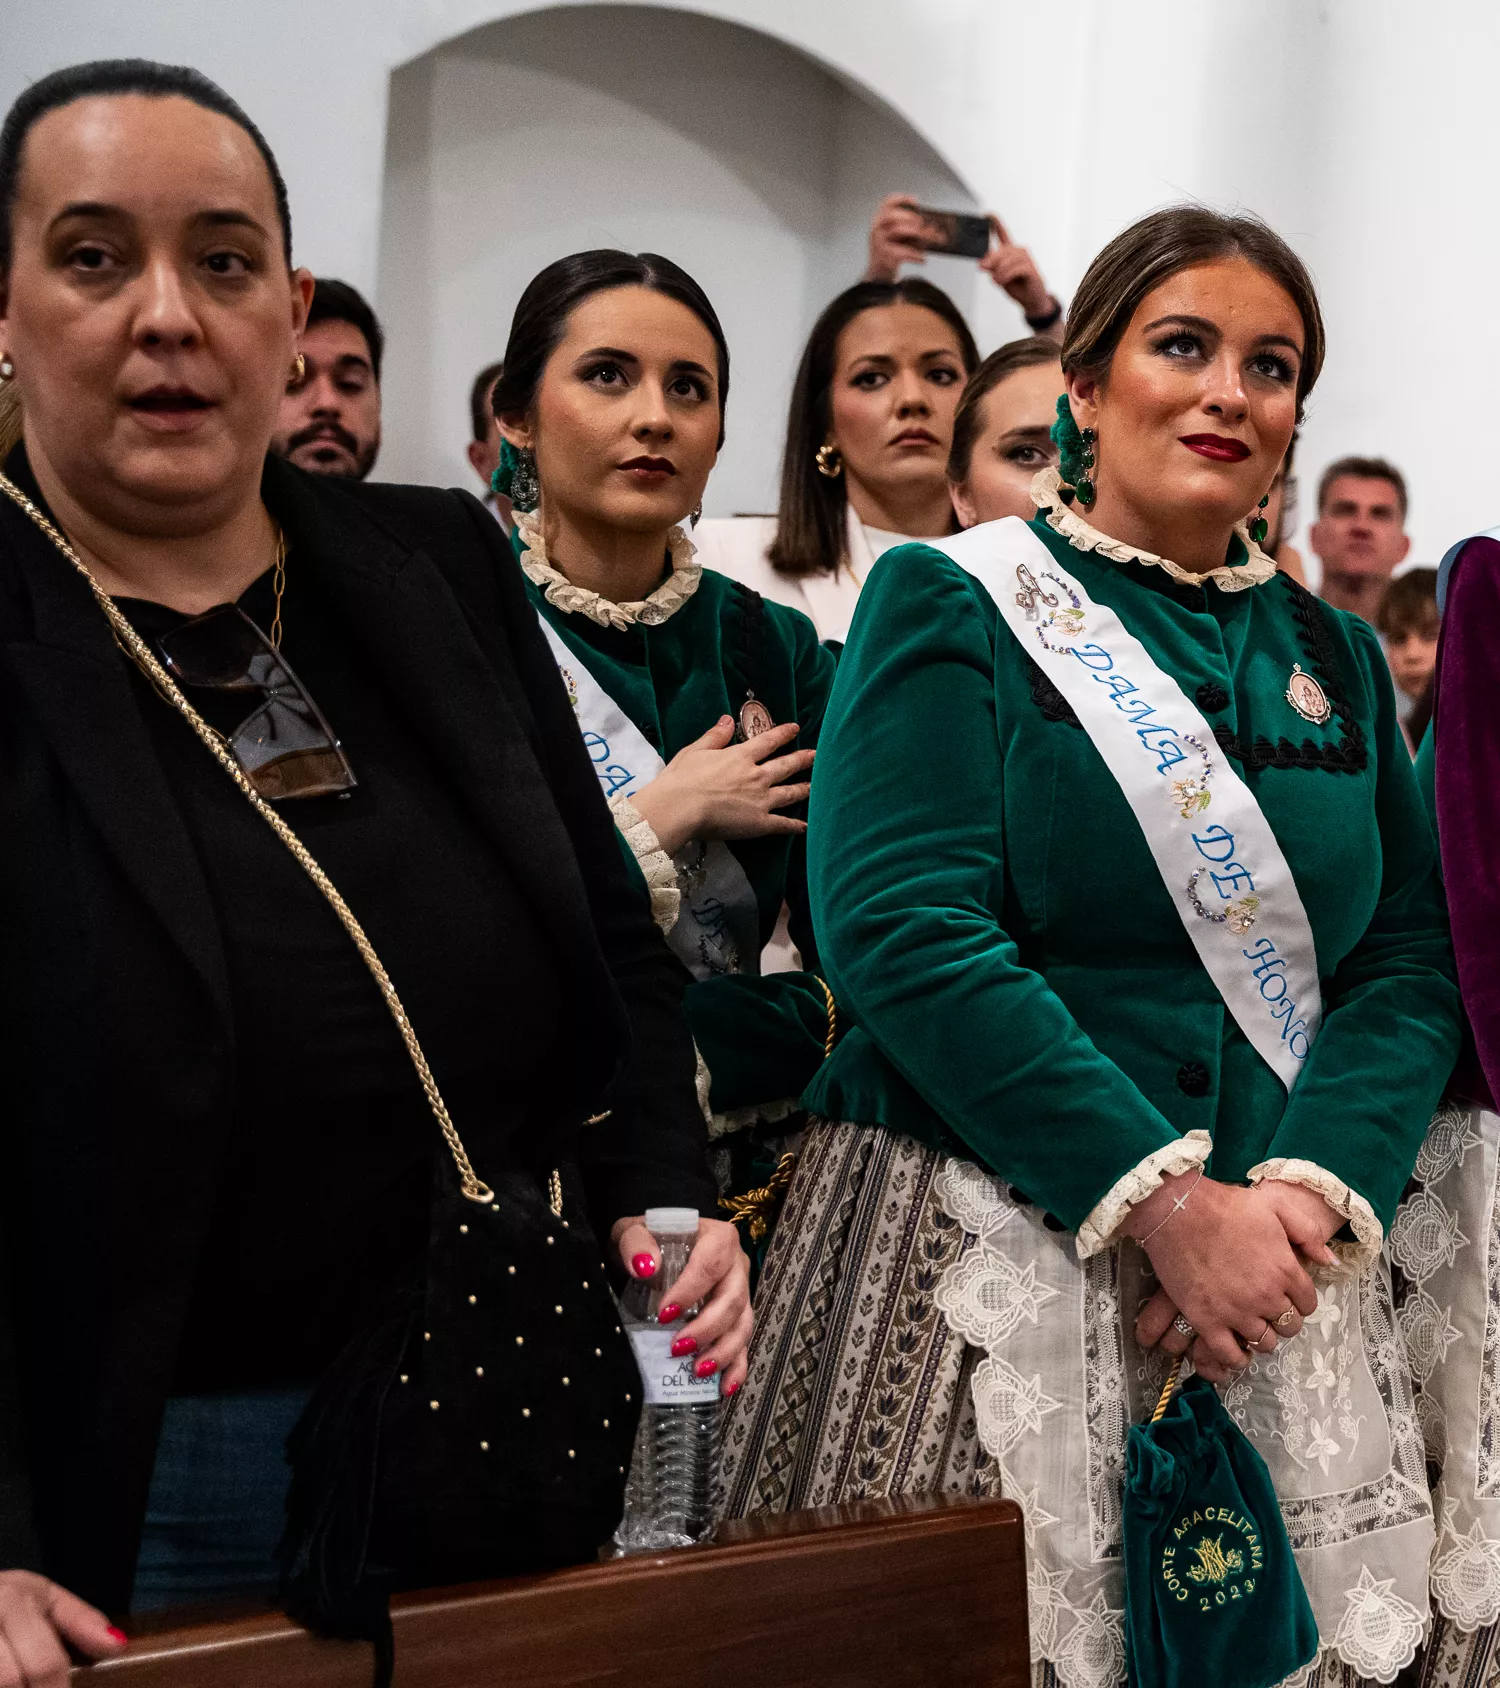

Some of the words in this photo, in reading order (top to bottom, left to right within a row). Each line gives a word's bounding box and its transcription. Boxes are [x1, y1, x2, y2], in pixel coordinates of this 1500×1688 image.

[582, 731, 637, 798] DA
[1071, 643, 1188, 777] DAMA
[1191, 824, 1257, 900] DE
[662, 1375, 685, 1387] DEL
[1173, 1506, 1264, 1570] ARACELITANA
[1162, 1546, 1188, 1601] CORTE
[1200, 1578, 1256, 1612] 2023
